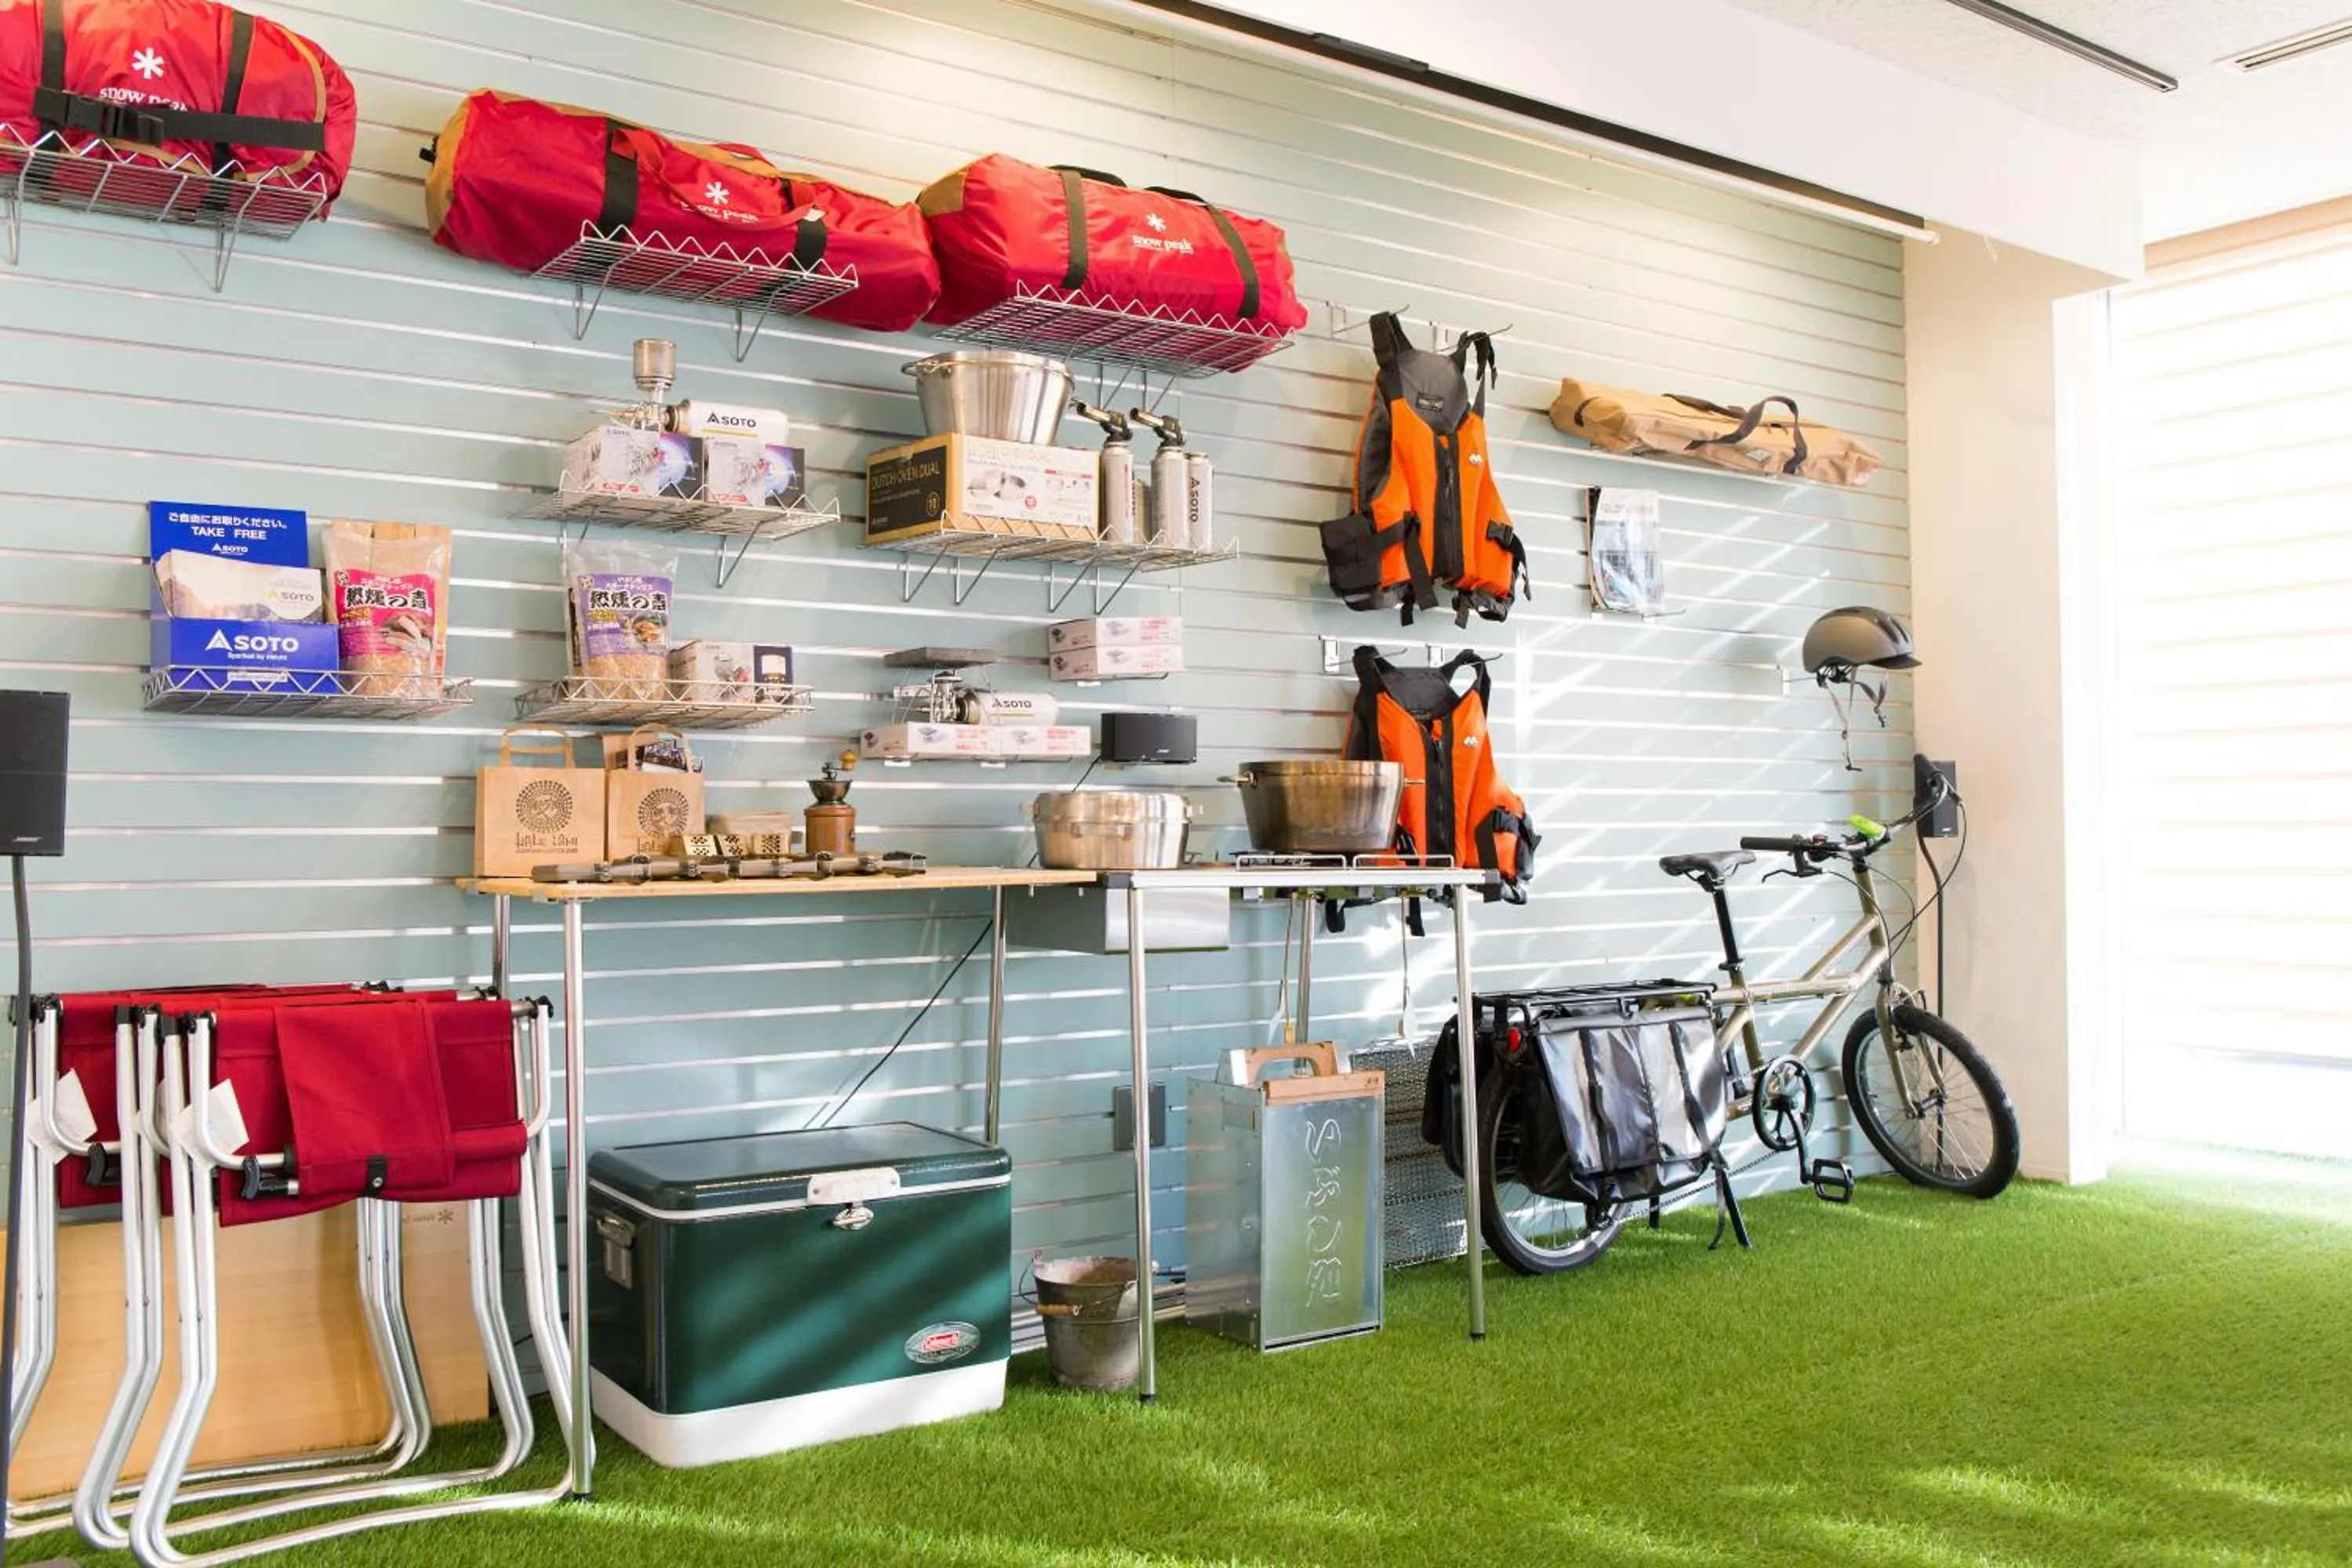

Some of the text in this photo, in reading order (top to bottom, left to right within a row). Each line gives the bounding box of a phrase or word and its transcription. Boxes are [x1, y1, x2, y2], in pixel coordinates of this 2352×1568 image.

[100, 88, 144, 103] snow
[720, 415, 757, 427] SOTO
[1189, 490, 1199, 523] SOTO
[169, 512, 288, 529] ご自由にお取りください。
[191, 526, 267, 540] TAKE FREE
[281, 591, 314, 601] SOTO
[234, 635, 299, 652] SOTO
